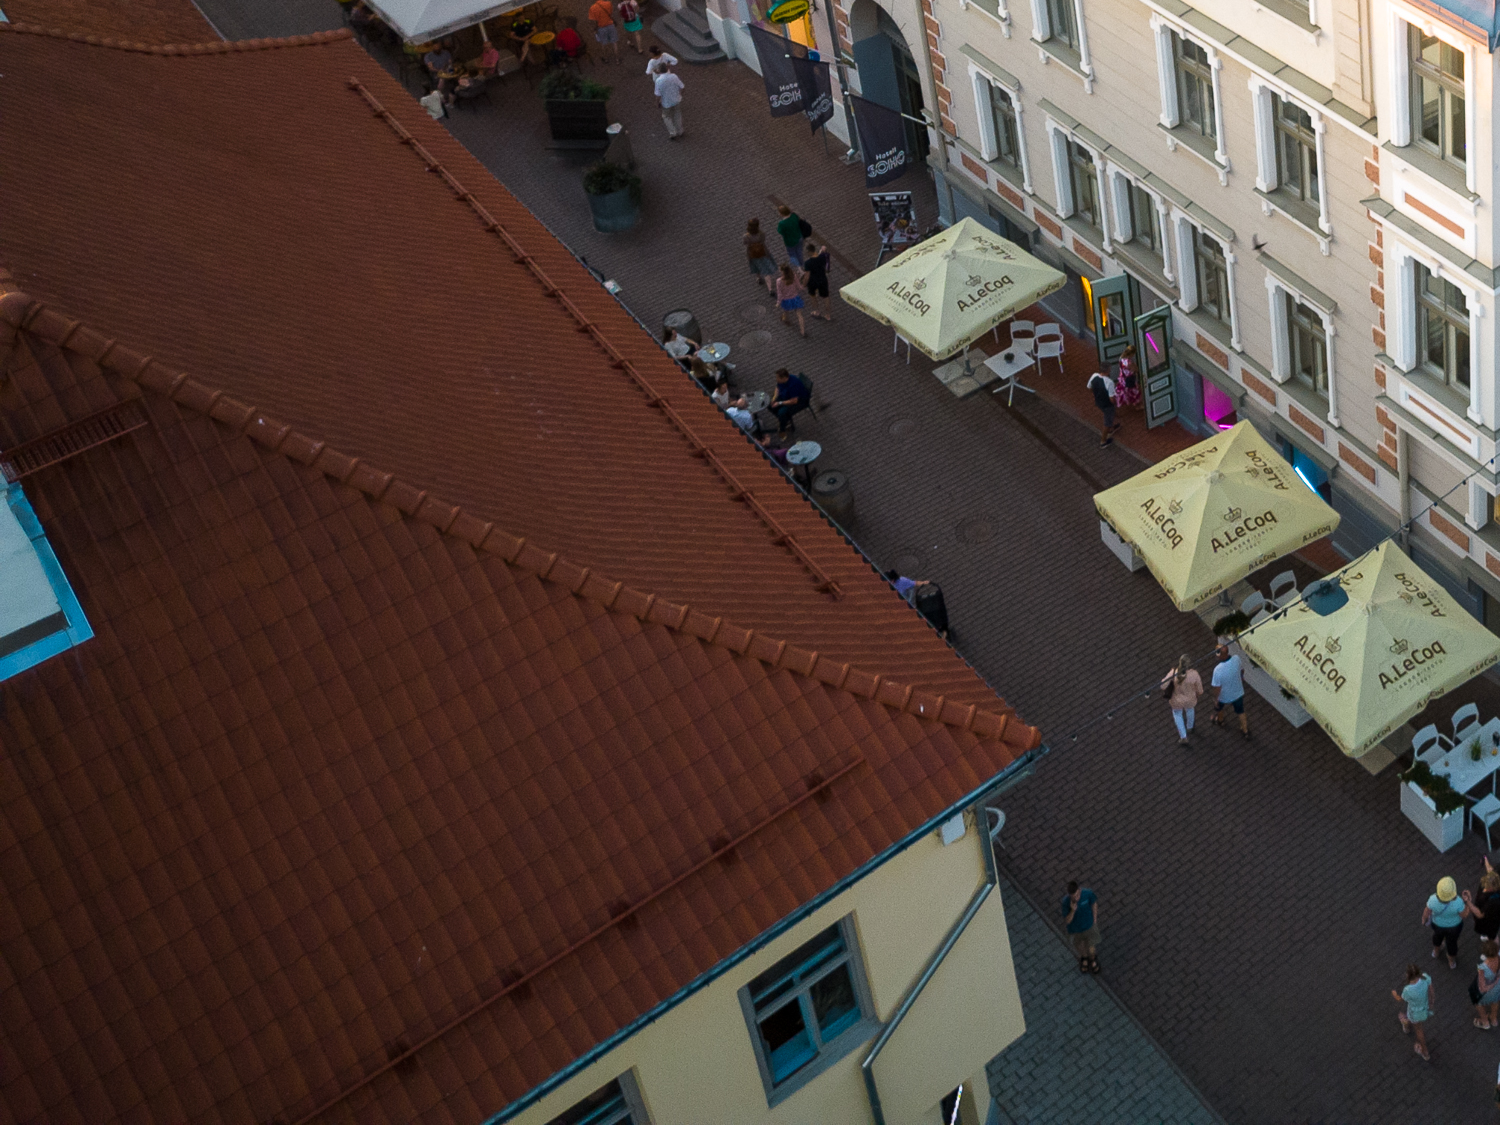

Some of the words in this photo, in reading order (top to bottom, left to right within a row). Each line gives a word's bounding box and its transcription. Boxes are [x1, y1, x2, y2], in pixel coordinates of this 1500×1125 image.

[770, 89, 802, 108] SOH
[779, 82, 798, 92] Hote
[876, 146, 897, 161] Hotell
[887, 281, 931, 317] A.LeCoq
[957, 274, 1014, 312] A.LeCoq
[1154, 446, 1219, 479] A.LeCoq
[1245, 450, 1290, 491] A.LeCoq
[1141, 497, 1184, 550] A.LeCoq
[1211, 509, 1279, 553] A.LeCoq
[1395, 572, 1448, 618] A.LeCoq
[1294, 634, 1347, 693] A.LeCoq
[1378, 640, 1448, 690] A.LeCoq
